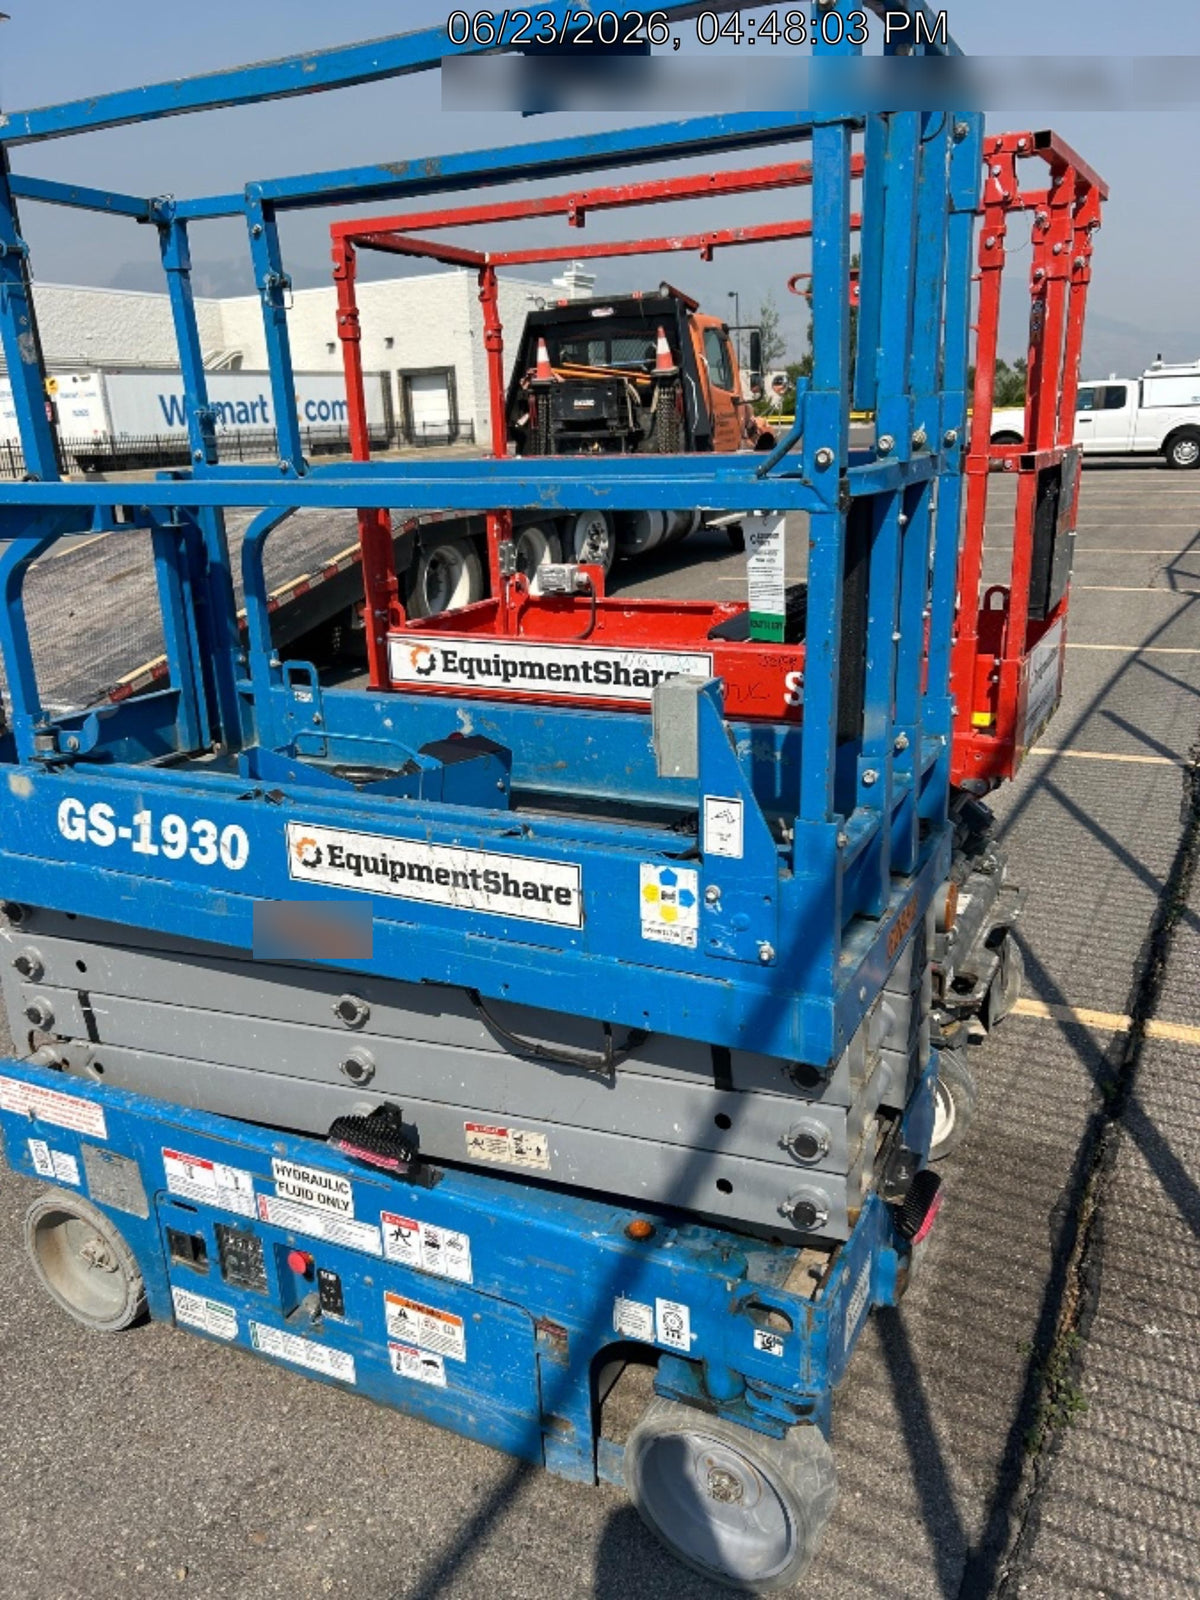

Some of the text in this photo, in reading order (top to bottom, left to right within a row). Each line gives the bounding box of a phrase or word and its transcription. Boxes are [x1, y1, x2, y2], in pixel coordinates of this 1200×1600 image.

[57, 797, 249, 870] GS-1930
[326, 844, 572, 905] EquipmentShare
[274, 1163, 349, 1195] HYDRAULIC
[277, 1181, 350, 1211] FLUID ONLY
